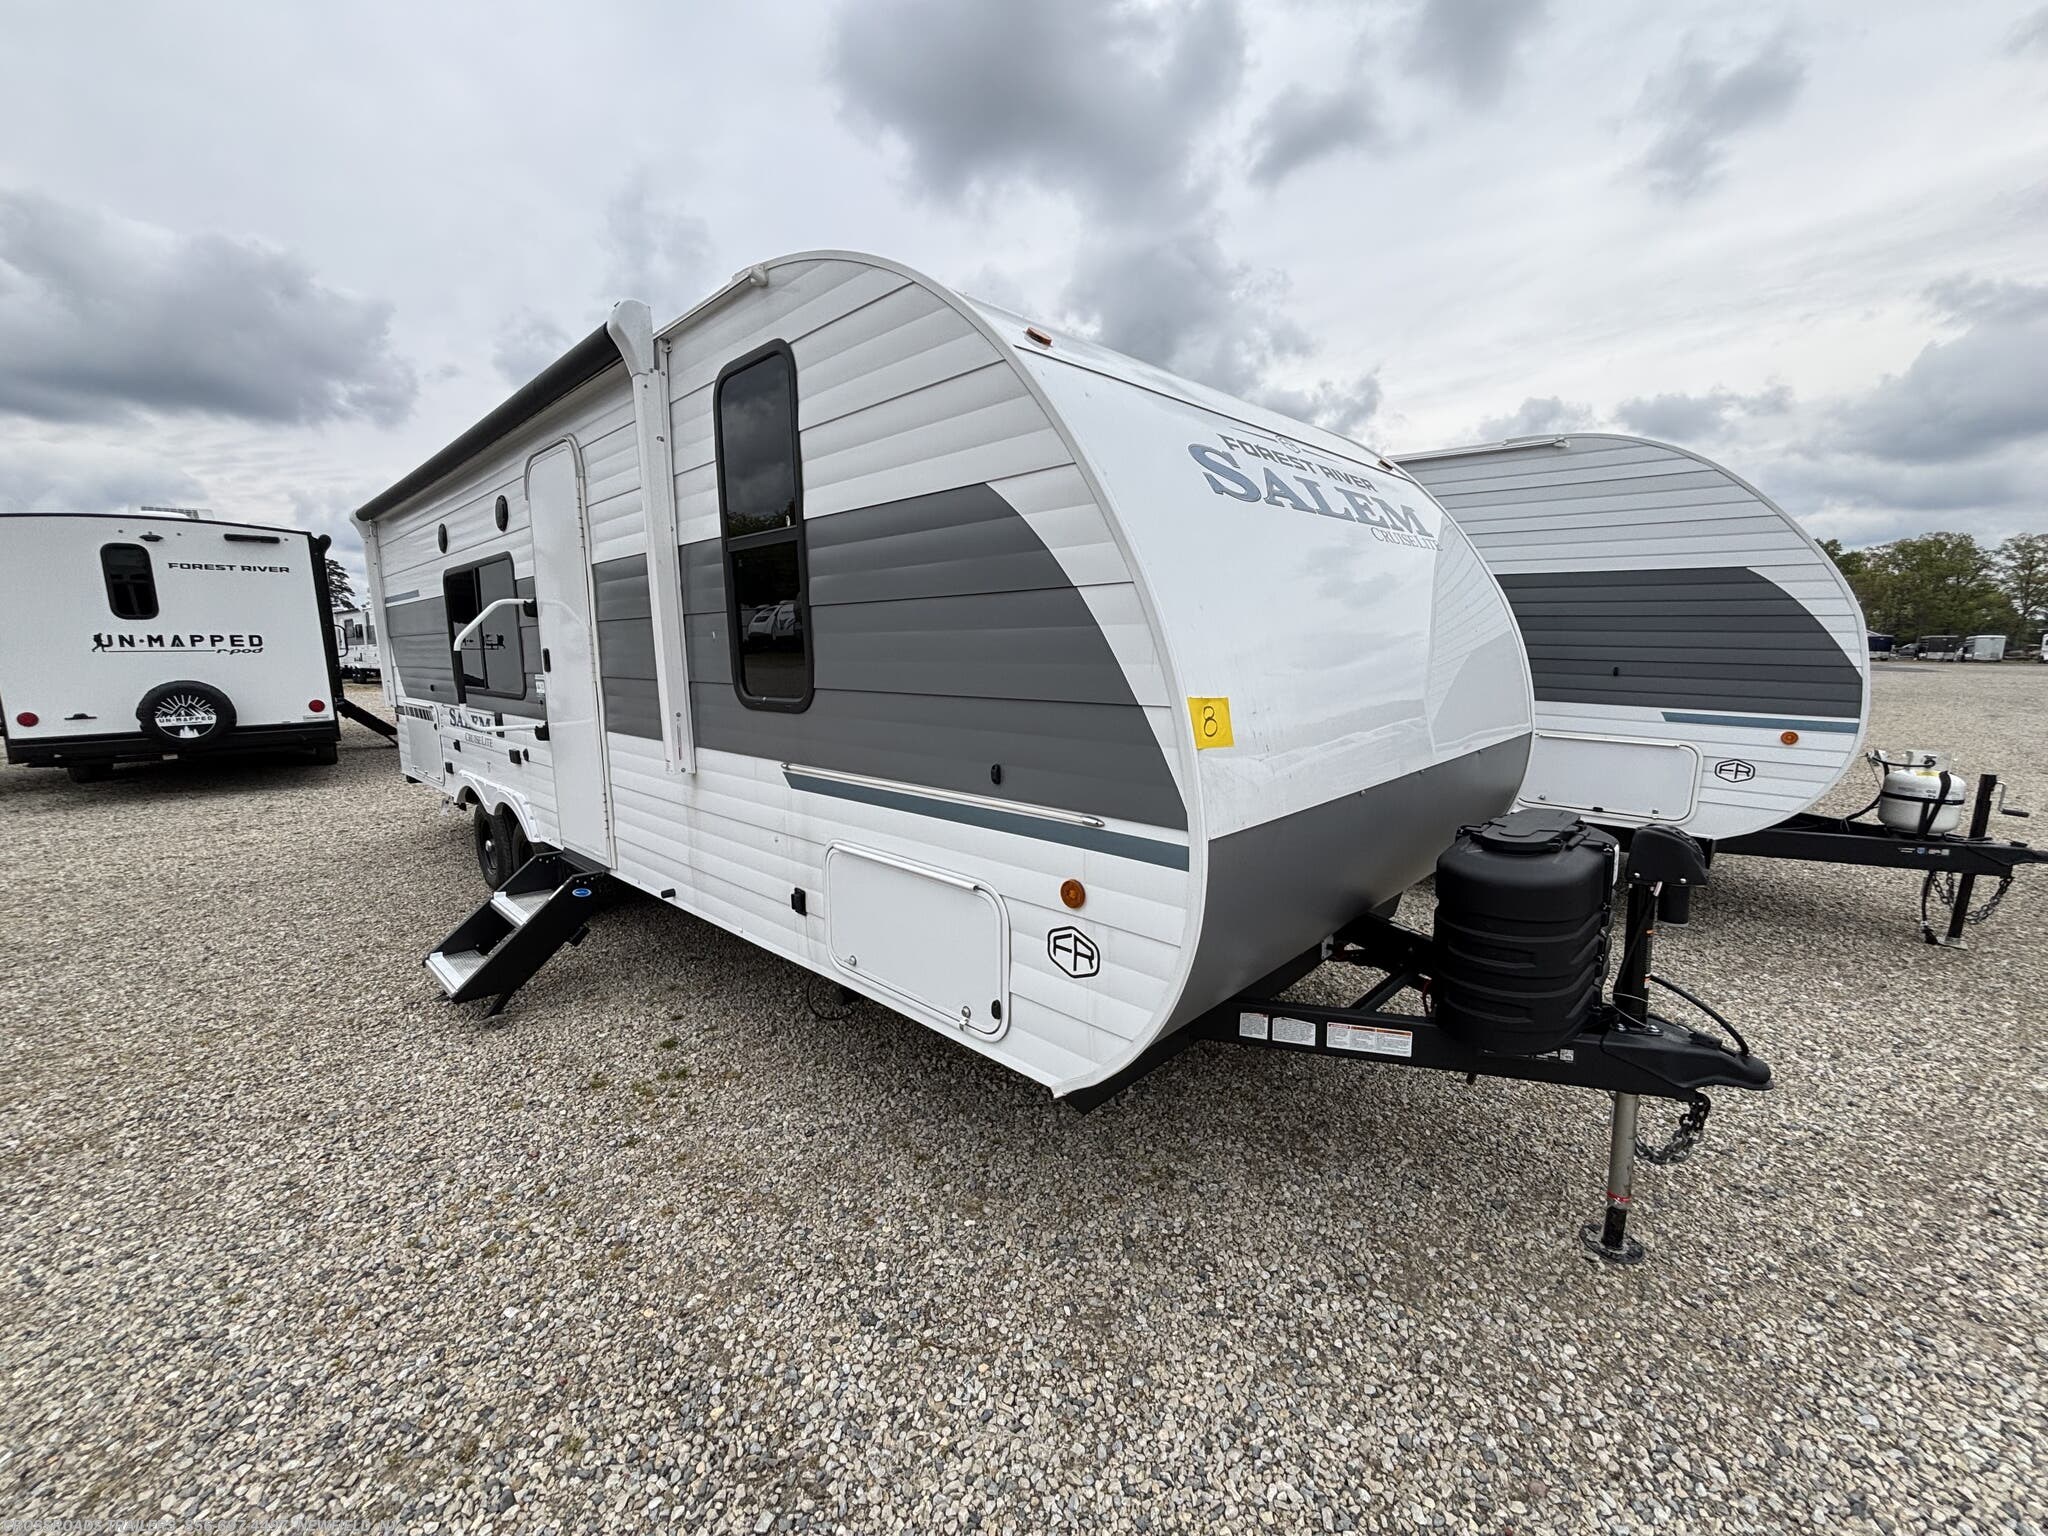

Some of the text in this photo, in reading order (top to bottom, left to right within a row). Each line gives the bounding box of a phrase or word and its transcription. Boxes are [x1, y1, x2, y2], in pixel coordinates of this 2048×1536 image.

[1216, 433, 1319, 474] FOREST
[1321, 464, 1377, 493] RIVER
[1187, 442, 1434, 538] SALEM
[168, 562, 290, 573] FOREST RIVER
[1202, 705, 1218, 737] 8
[1717, 762, 1752, 780] FR
[1052, 932, 1096, 972] FR
